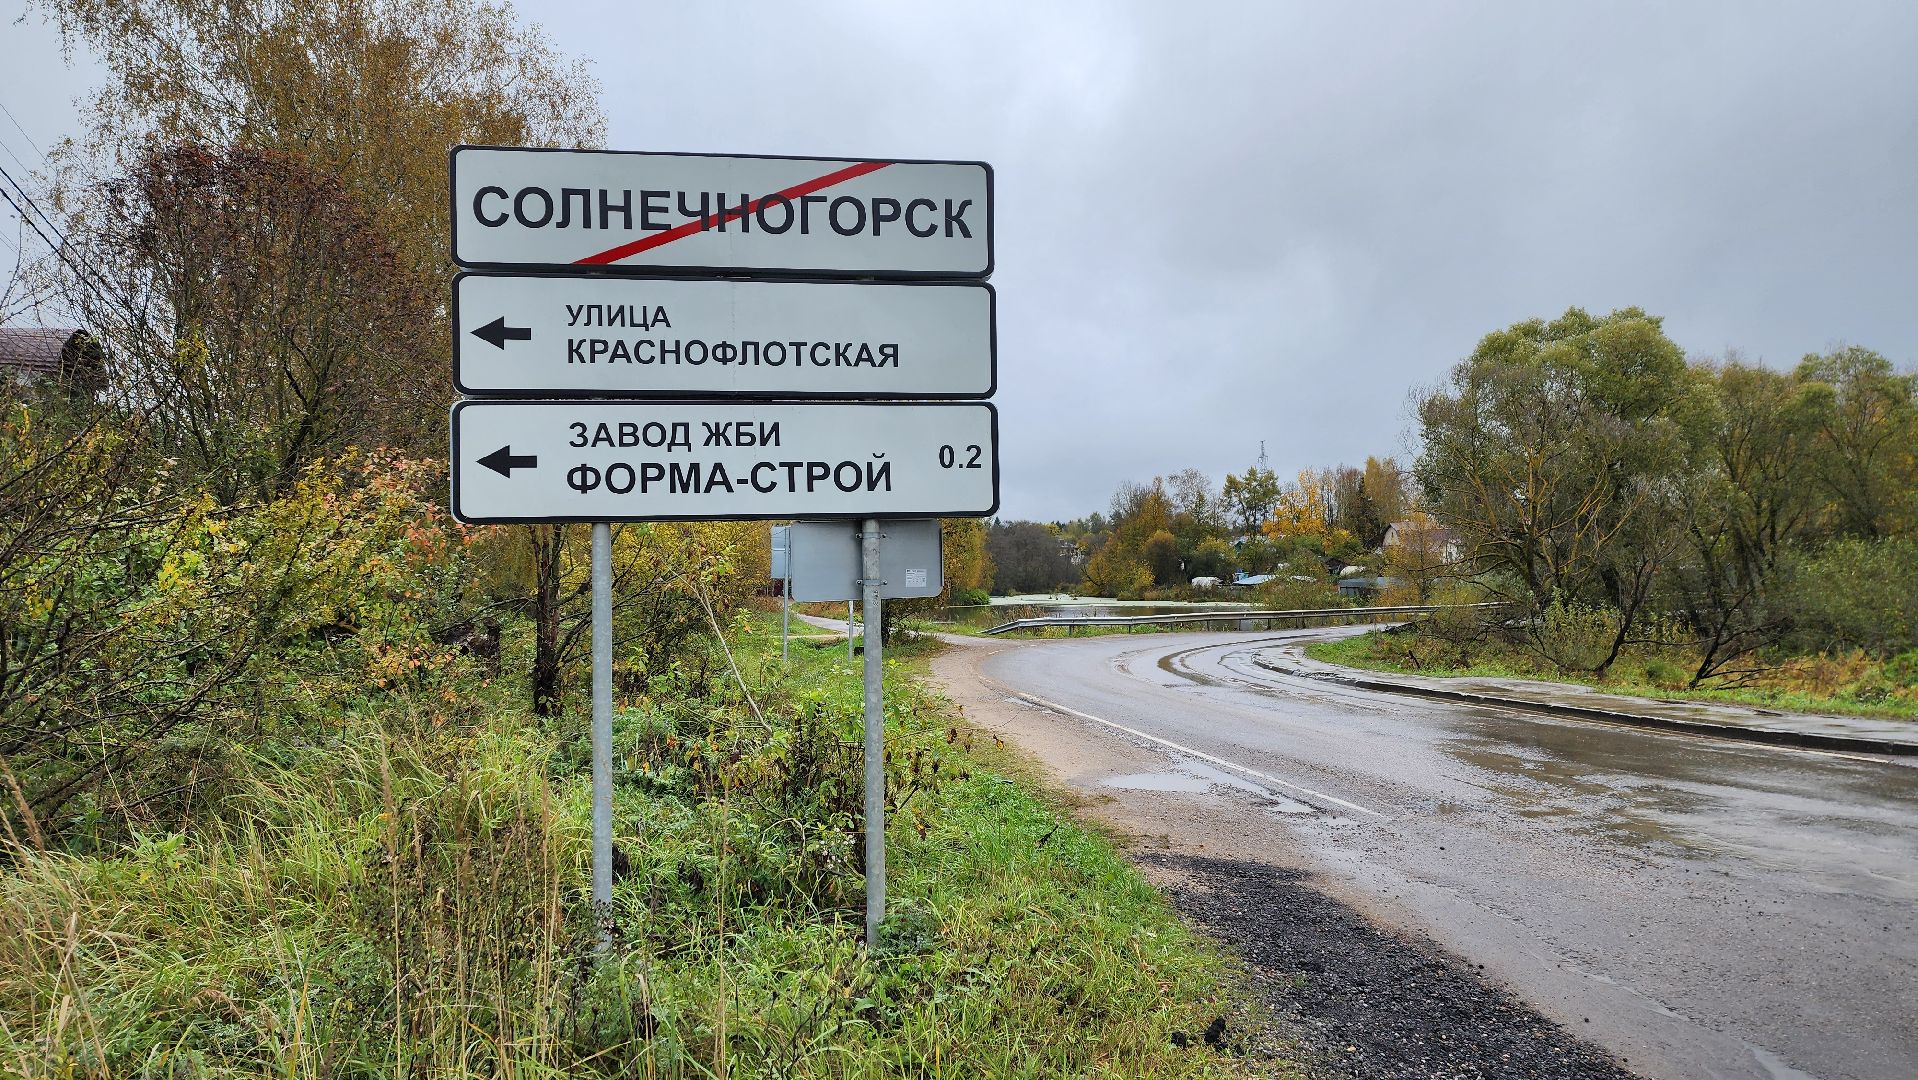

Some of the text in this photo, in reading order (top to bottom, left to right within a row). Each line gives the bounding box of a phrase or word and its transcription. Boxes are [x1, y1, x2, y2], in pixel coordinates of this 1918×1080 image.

[473, 186, 973, 239] СОЛНЕЧНОГОРСК
[566, 305, 672, 330] УЛИЦА
[567, 339, 899, 368] КРАСНОФЛОТСКАЯ
[569, 422, 781, 452] ЗАВОД ЖБИ
[938, 445, 982, 469] 0.2
[567, 452, 892, 494] ФОРМА-СТРОЙ
